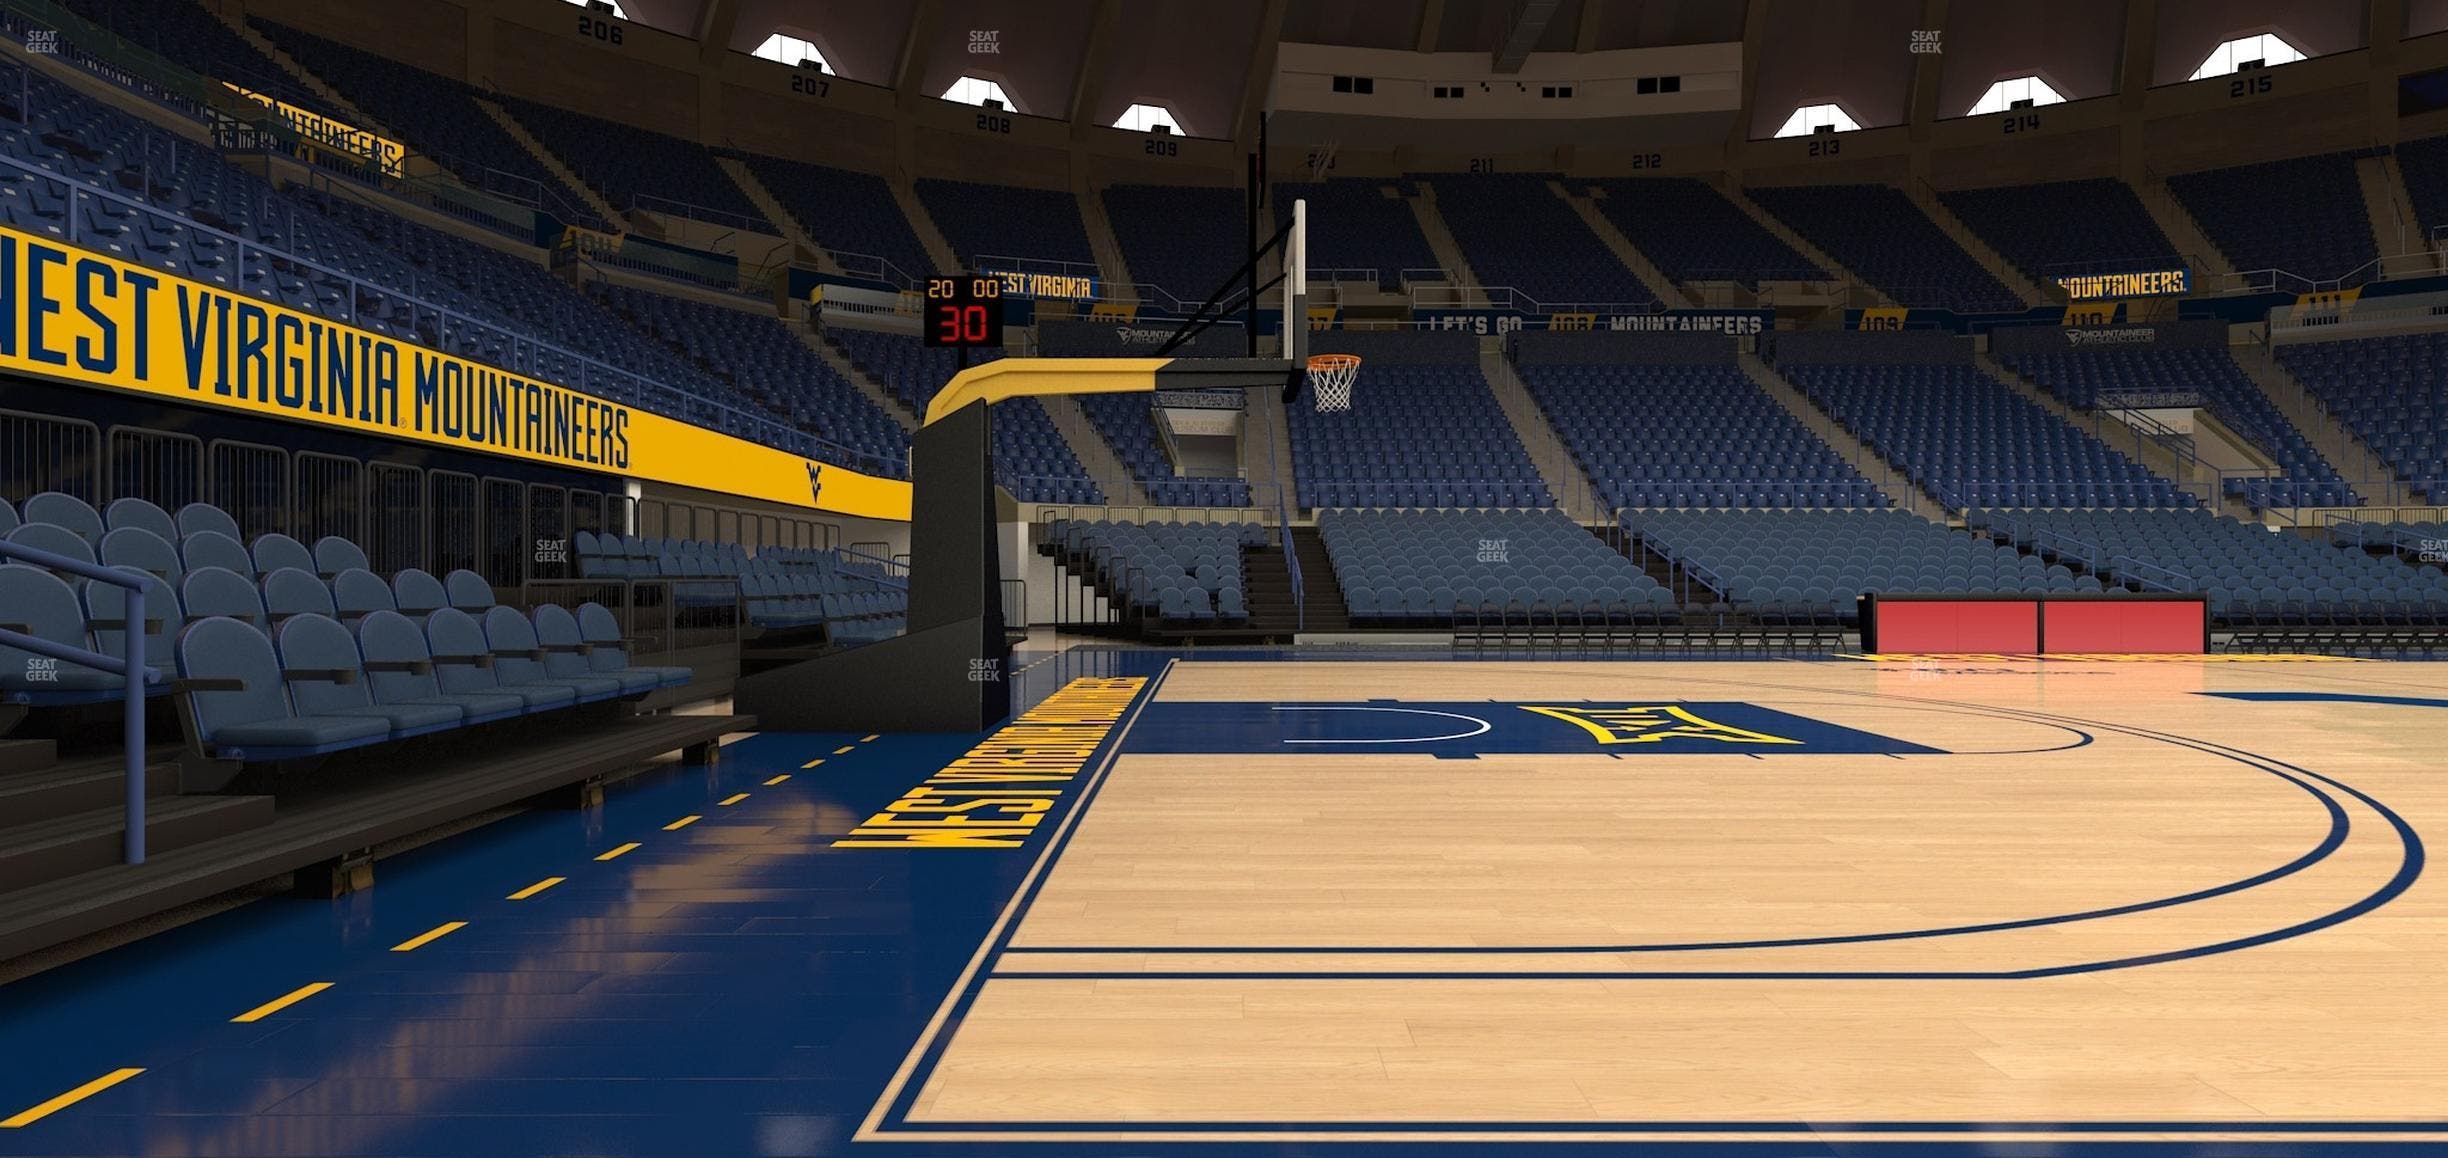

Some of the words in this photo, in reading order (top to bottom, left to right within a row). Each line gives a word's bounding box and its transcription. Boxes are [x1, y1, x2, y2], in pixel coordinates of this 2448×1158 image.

[579, 16, 623, 45] 206
[792, 75, 829, 98] 207
[2231, 75, 2273, 97] 215
[977, 115, 1010, 134] 208
[2004, 114, 2040, 134] 214
[1146, 140, 1177, 157] 209
[1809, 140, 1839, 156] 213
[1470, 158, 1493, 173] 211
[1633, 154, 1661, 169] 212
[1028, 274, 1091, 298] VIRGINIA
[940, 305, 987, 341] 30
[176, 284, 399, 428] VIRGINIA
[415, 351, 629, 469] MOUNTAINEERS
[830, 786, 1063, 848] WEST
